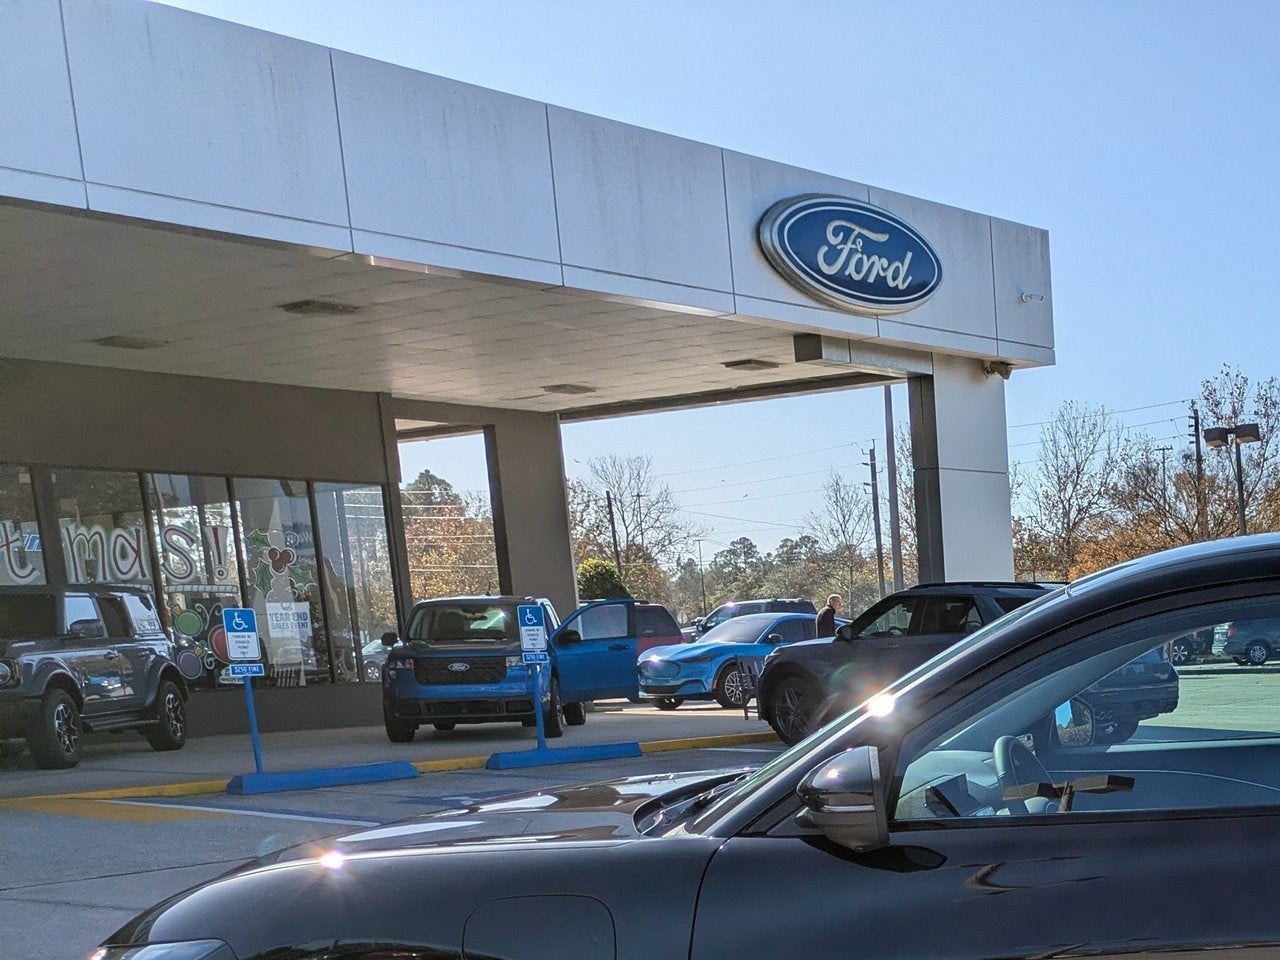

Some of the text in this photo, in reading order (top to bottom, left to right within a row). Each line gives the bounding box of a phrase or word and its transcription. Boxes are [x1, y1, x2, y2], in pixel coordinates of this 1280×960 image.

[816, 219, 913, 290] Ford
[269, 612, 308, 622] YEAR END
[271, 622, 290, 630] SALES
